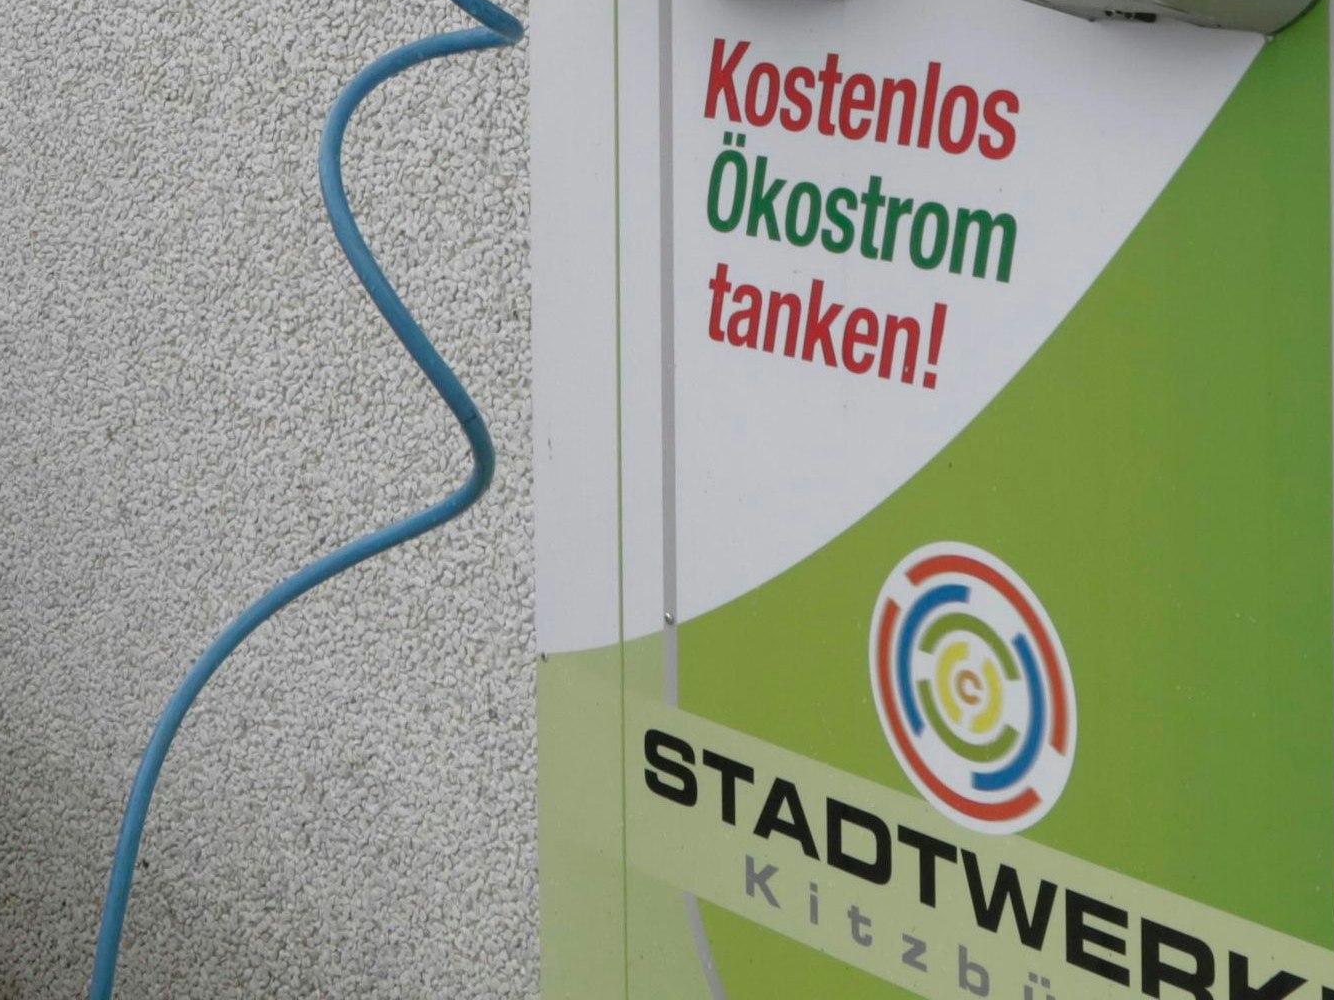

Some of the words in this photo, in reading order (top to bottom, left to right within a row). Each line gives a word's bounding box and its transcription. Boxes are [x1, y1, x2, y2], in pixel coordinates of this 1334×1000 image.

[704, 38, 1020, 160] Kostenlos
[707, 131, 1017, 283] Ökostrom
[708, 262, 947, 390] tanken!
[744, 855, 1055, 1000] Kitzb
